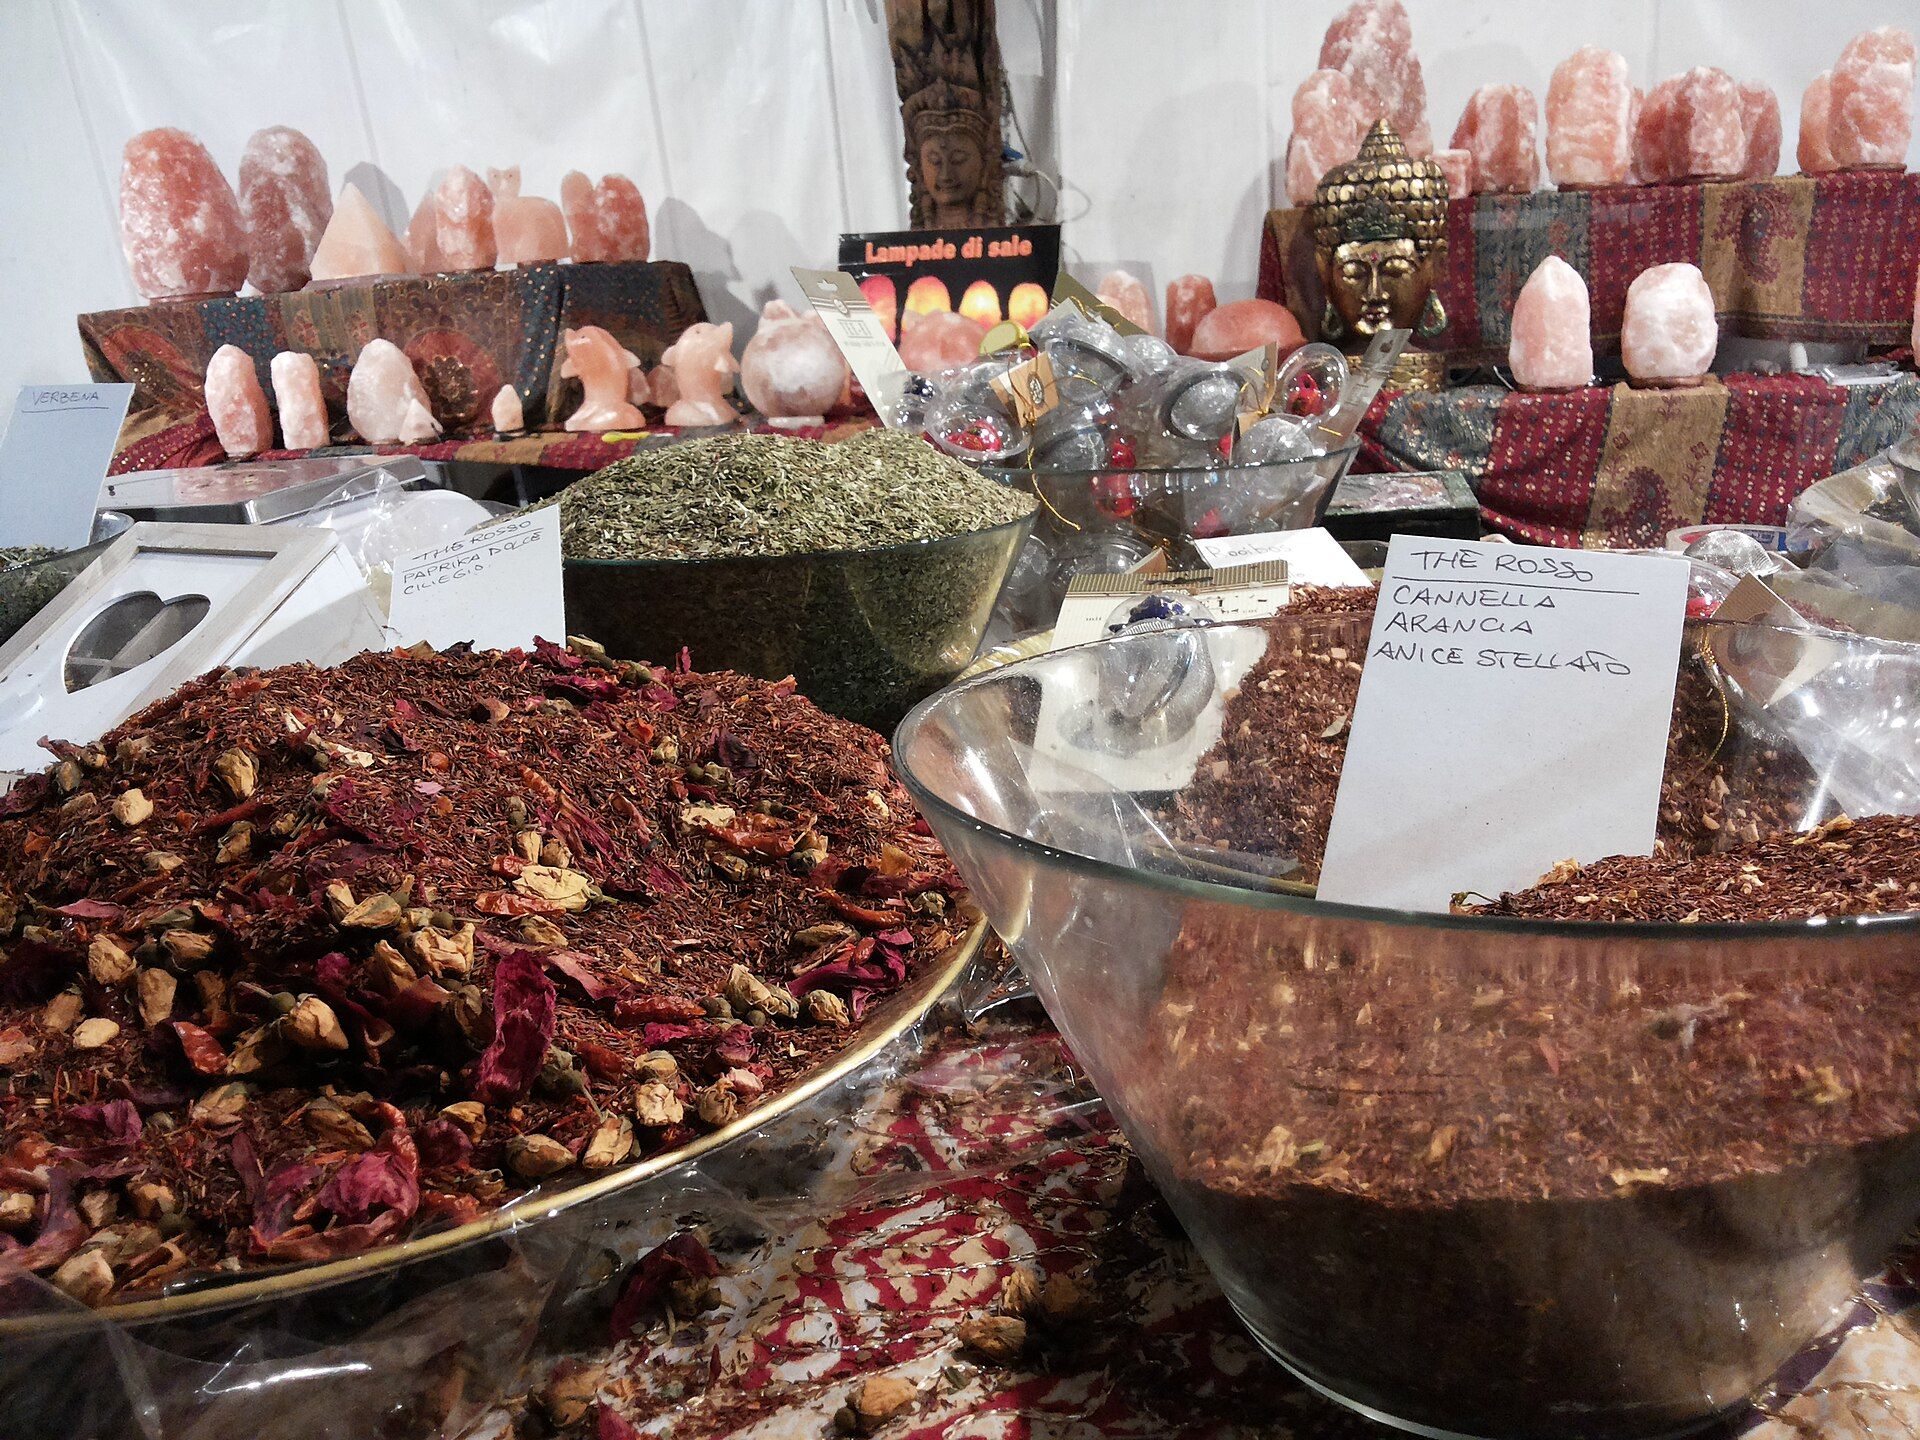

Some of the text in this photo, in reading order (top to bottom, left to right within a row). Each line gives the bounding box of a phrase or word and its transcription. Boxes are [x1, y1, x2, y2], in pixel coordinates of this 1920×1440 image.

[865, 234, 1033, 268] Lampade di sale
[32, 391, 99, 406] VERBENA
[403, 531, 542, 584] PAPRIKA DOLCE
[412, 520, 532, 561] THE ROSSO
[1410, 548, 1594, 582] THE ROSSO
[1393, 584, 1556, 609] CANNELLA
[1384, 611, 1533, 635] ARANCIA
[1373, 641, 1631, 676] ANICE STELLATO
